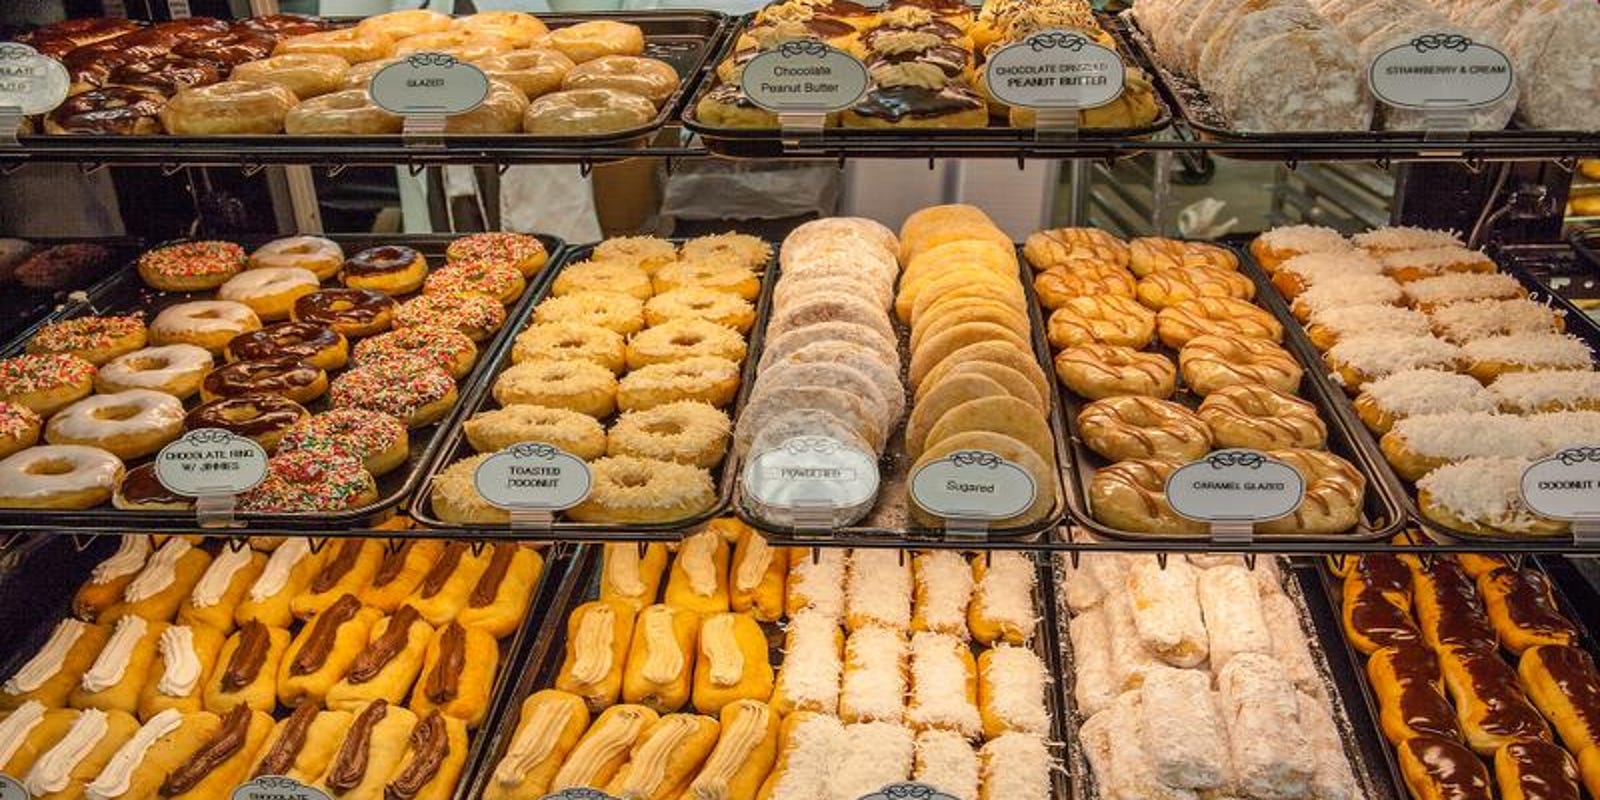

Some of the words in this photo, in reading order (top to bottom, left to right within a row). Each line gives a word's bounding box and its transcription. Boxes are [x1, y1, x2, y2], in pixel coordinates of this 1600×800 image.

[773, 66, 832, 77] Chocolate
[996, 64, 1056, 76] CHOCOLATE
[1386, 66, 1456, 75] STRAWBERRY
[1459, 65, 1466, 74] &
[1469, 65, 1506, 75] CREAM
[406, 78, 445, 88] GLAZED
[1007, 77, 1056, 88] PEANUT
[1059, 76, 1107, 87] BUTTER
[761, 83, 801, 93] Peanut
[805, 83, 839, 93] Butter
[166, 450, 226, 460] CHOCOLATE
[509, 466, 560, 476] TOASTED
[946, 481, 994, 495] Sugared
[1193, 482, 1241, 491] CARAMEL
[1244, 482, 1284, 491] GLAZED
[1538, 480, 1592, 490] COCONUT
